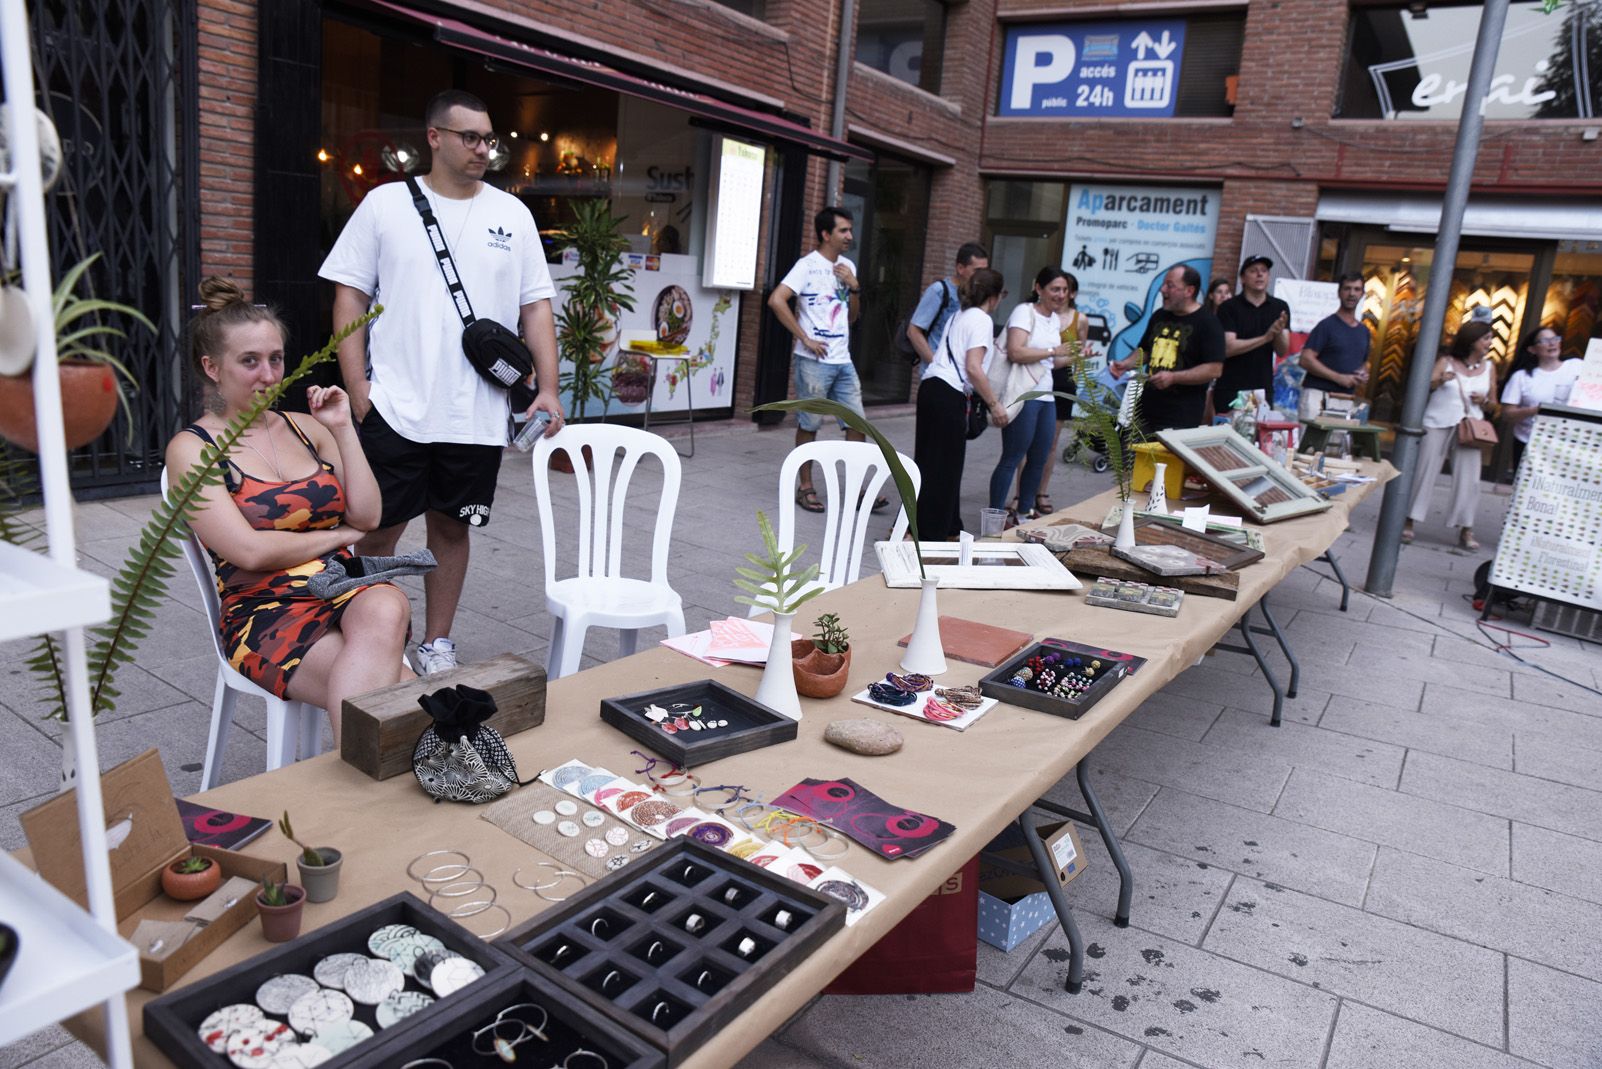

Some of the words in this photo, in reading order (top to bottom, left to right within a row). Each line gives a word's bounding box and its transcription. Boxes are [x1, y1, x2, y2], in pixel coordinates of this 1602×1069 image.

[1010, 34, 1076, 109] P
[1075, 84, 1114, 107] 24h
[1077, 187, 1209, 216] Aparcament
[1076, 216, 1129, 230] Promoparc
[1136, 219, 1171, 231] Doctor
[487, 241, 511, 252] adidas
[489, 358, 522, 387] PUMA
[459, 504, 477, 518] SKY
